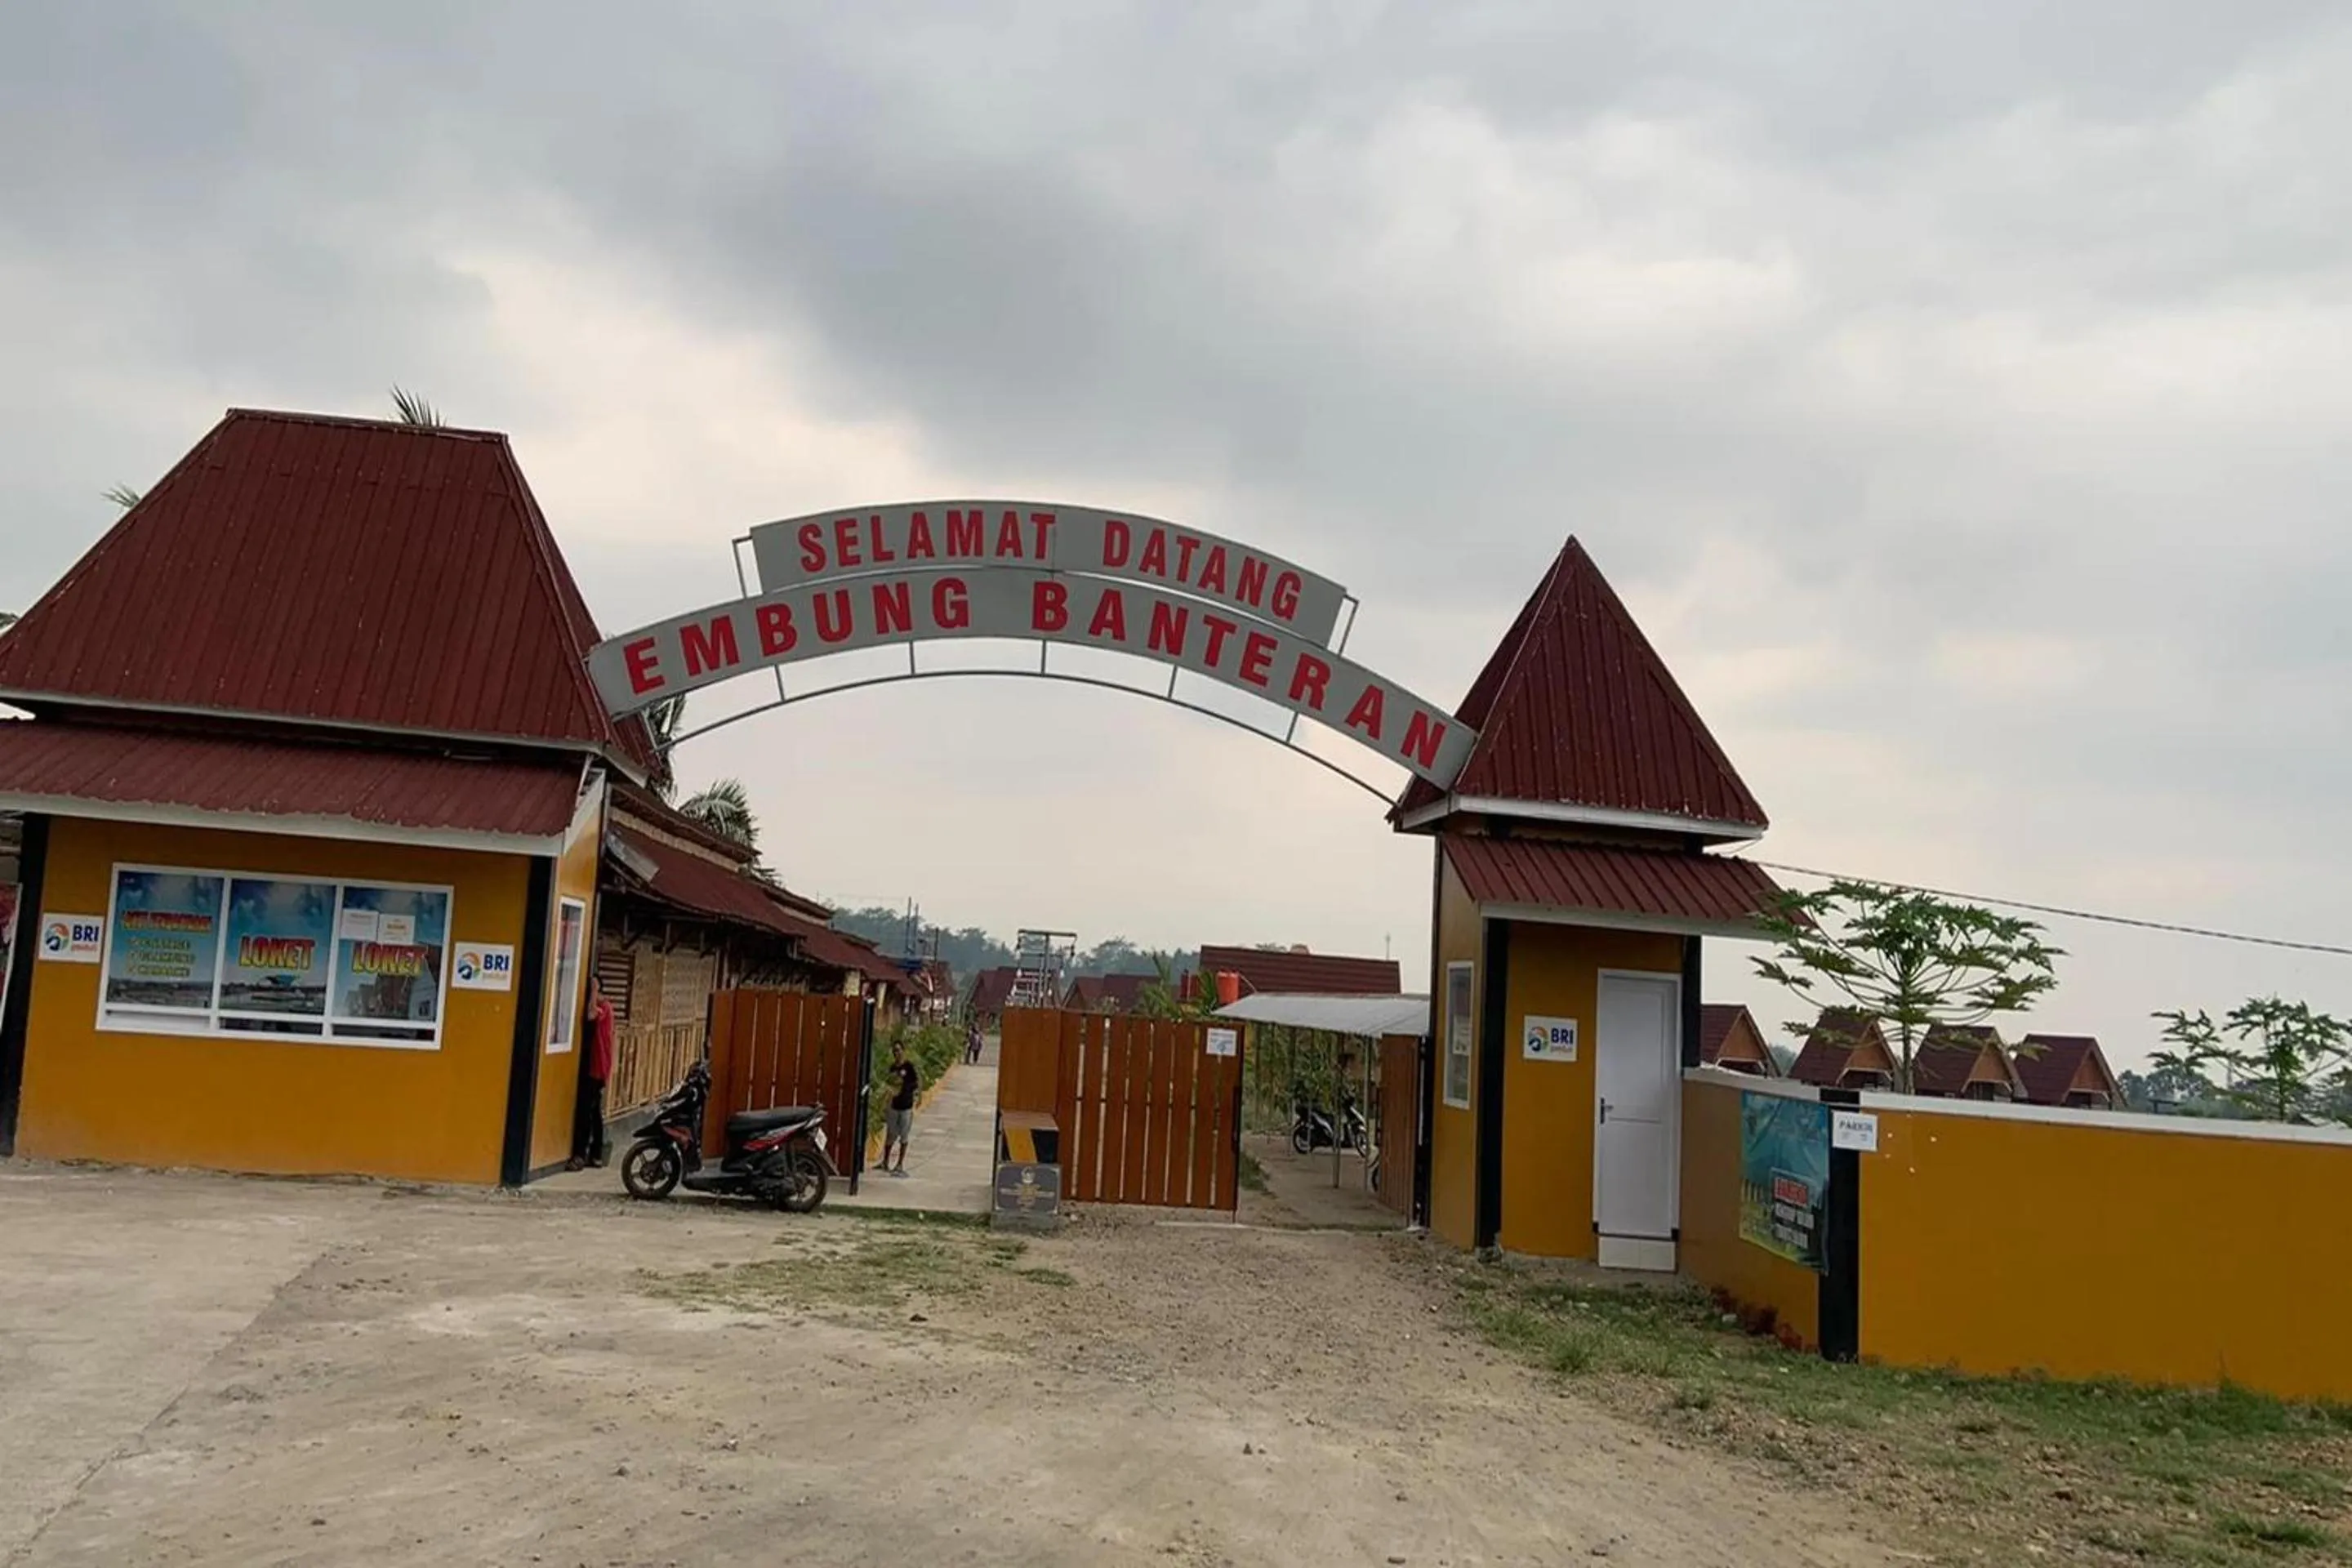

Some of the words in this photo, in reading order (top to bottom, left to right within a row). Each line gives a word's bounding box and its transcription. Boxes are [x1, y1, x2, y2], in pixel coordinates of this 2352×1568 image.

[797, 509, 1057, 572] SELAMAT
[1102, 519, 1303, 621] DATANG
[621, 576, 971, 696] EMBUNG
[1031, 580, 1447, 770] BANTERAN
[72, 924, 100, 942] BRI
[238, 935, 316, 971] LOKET
[351, 941, 429, 977] LOKET
[483, 953, 510, 972] BRI
[1551, 1027, 1575, 1045] BRI
